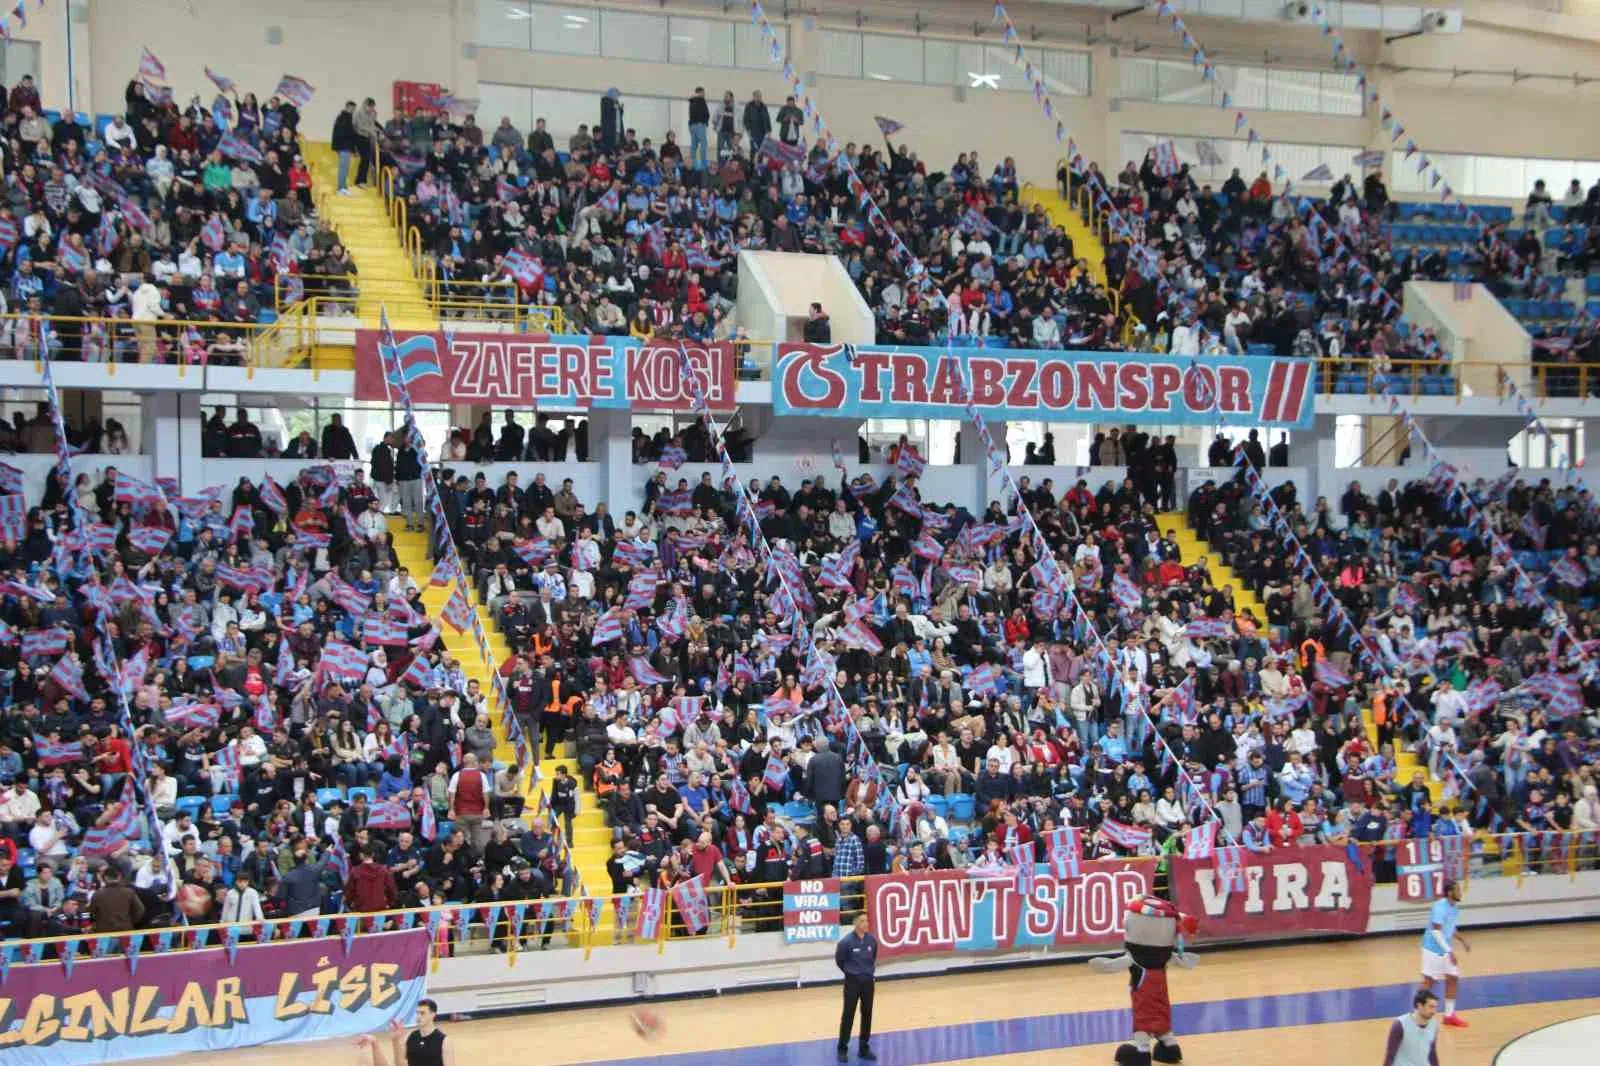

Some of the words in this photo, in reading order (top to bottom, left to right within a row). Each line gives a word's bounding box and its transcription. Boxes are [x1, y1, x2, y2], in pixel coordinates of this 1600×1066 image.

[451, 342, 615, 398] ZAFERE
[850, 351, 1253, 413] TRABZONSPOR
[794, 894, 829, 908] VIRA
[800, 880, 823, 893] NO
[1195, 861, 1353, 916] VIRA
[799, 910, 822, 924] NO
[875, 876, 1015, 948] CAN'T
[1024, 870, 1146, 937] STOP
[786, 925, 835, 940] PARTY
